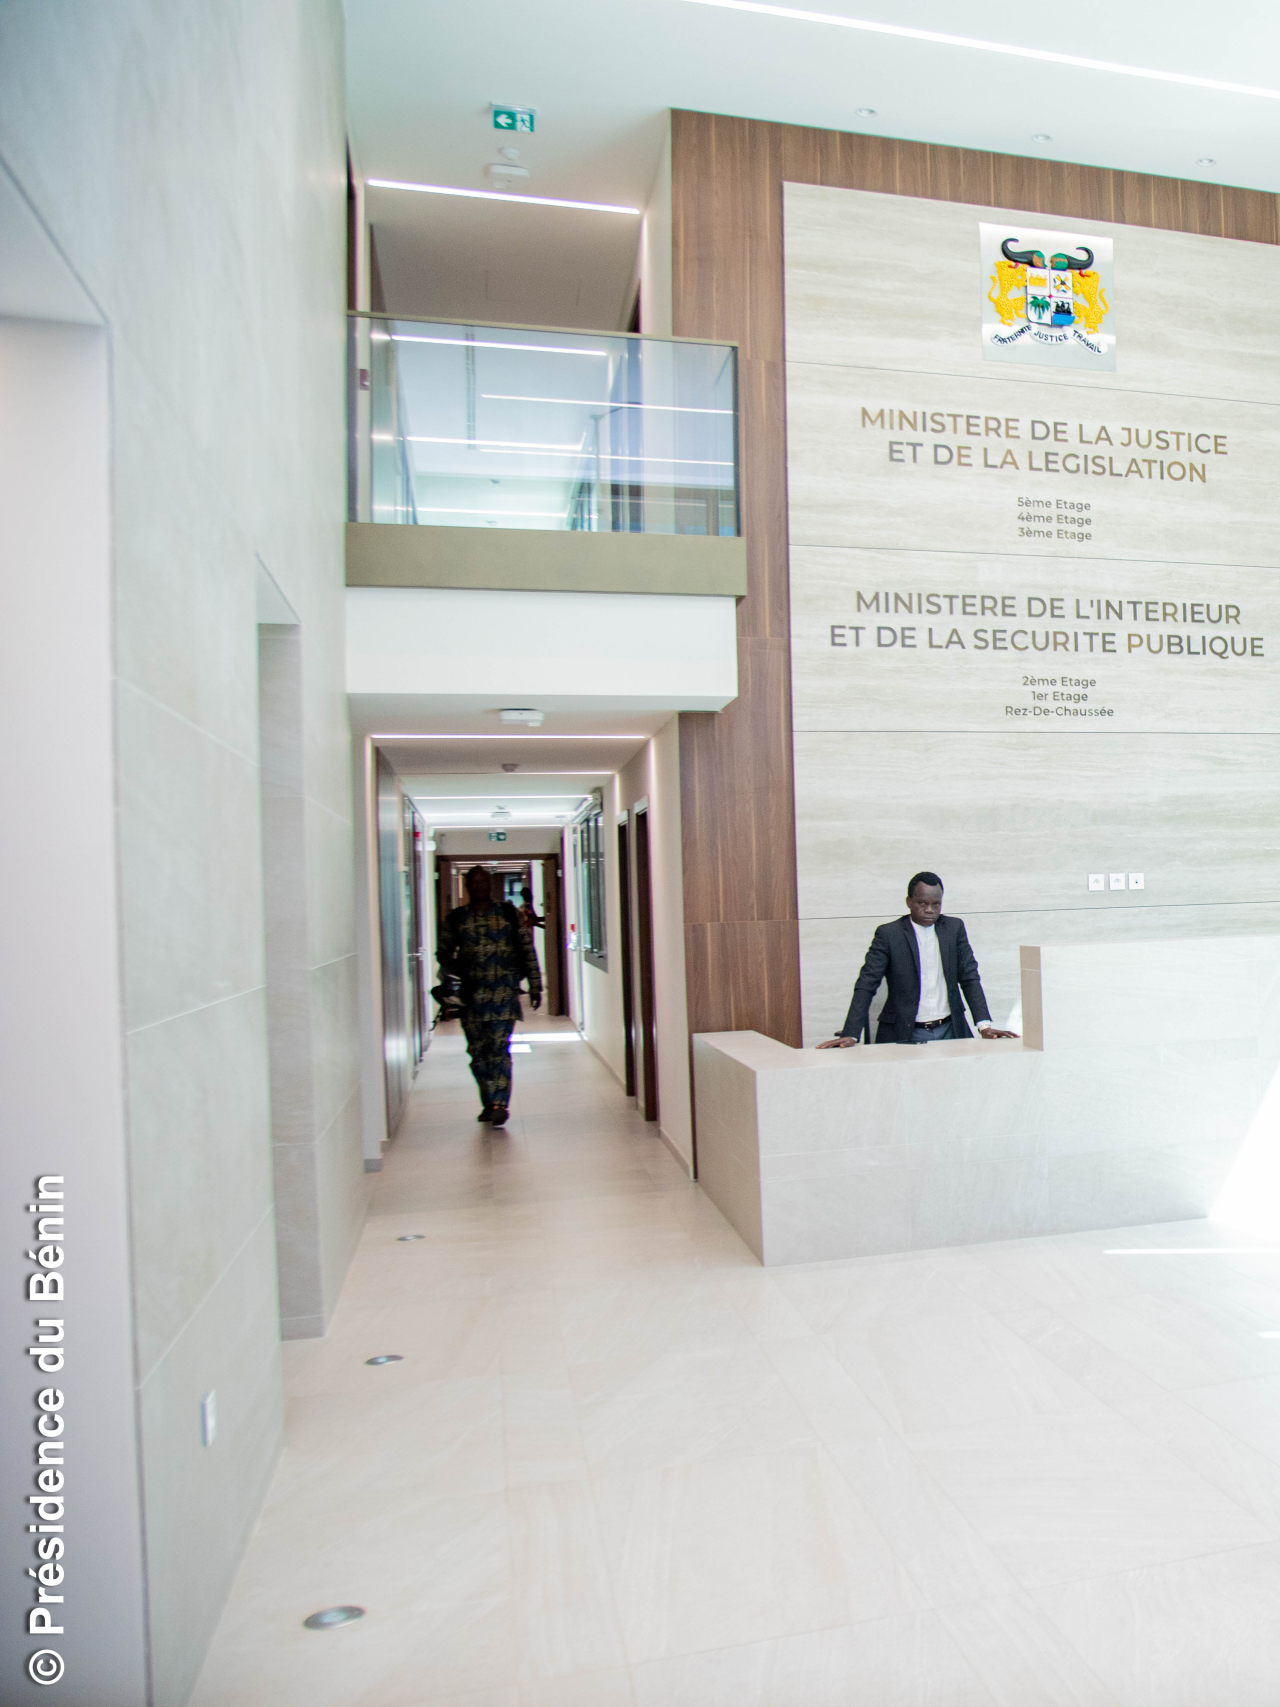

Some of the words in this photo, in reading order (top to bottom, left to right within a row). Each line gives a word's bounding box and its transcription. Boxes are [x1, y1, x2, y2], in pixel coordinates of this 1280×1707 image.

[1034, 331, 1069, 342] JUSTICE
[1073, 330, 1101, 353] TRAVAIL
[860, 407, 1020, 439] MINISTERE
[1030, 419, 1068, 443] DE
[1078, 423, 1114, 446] LA
[1120, 427, 1228, 455] JUSTICE
[888, 441, 923, 463] ET
[933, 444, 972, 467] DE
[983, 448, 1019, 470] LA
[1028, 451, 1207, 483] LEGISLATION
[1017, 497, 1052, 509] 5ème
[1056, 499, 1091, 512] Etage
[1017, 512, 1052, 523] 4ème
[1056, 514, 1092, 528] Etage
[1018, 527, 1053, 538] 3ème
[1056, 529, 1092, 542] Etage
[856, 590, 1017, 617] MINISTERE
[1028, 597, 1065, 618] DE
[1075, 599, 1241, 625] L'INTERIEUR
[830, 624, 865, 647] ET
[876, 626, 916, 648] DE
[928, 628, 965, 650] LA
[973, 629, 1117, 653] SECURITE
[1127, 633, 1265, 660] PUBLIQUE
[1022, 675, 1057, 687] 2ème
[1061, 677, 1096, 690] Etage
[1031, 690, 1050, 701] 1er
[1053, 690, 1088, 703] Etage
[1005, 705, 1114, 717] Rez-De-Chaussée
